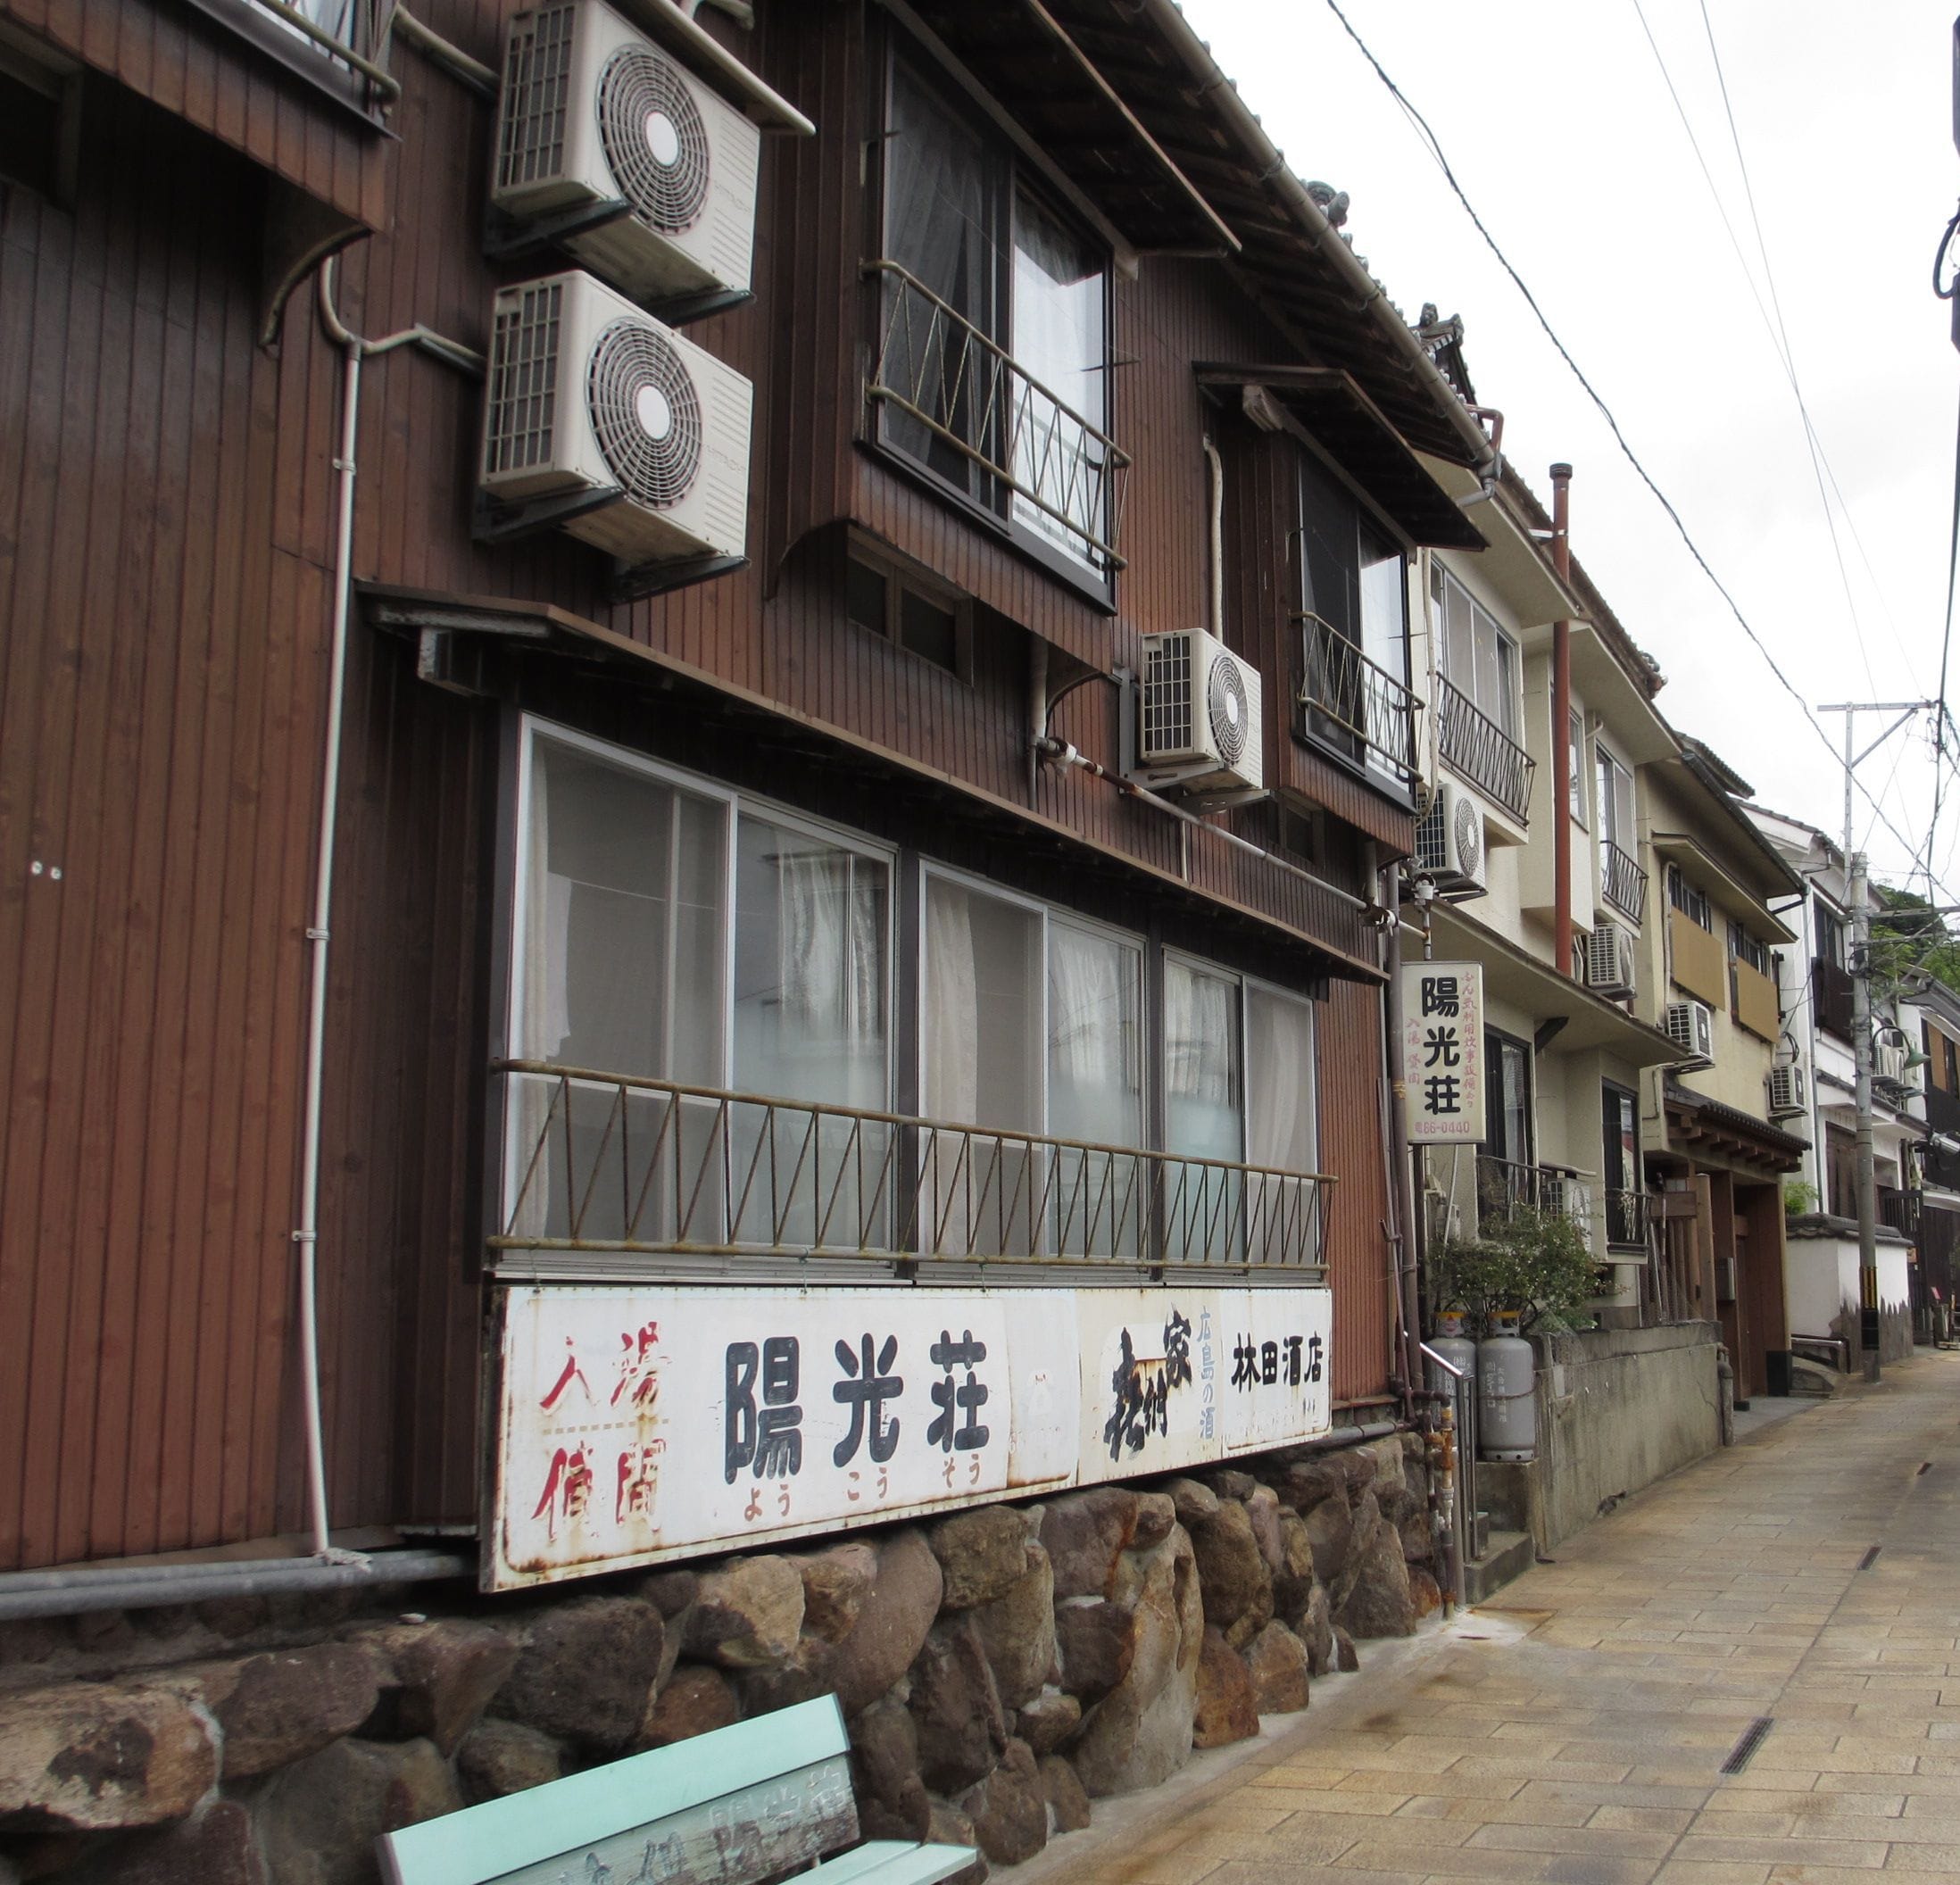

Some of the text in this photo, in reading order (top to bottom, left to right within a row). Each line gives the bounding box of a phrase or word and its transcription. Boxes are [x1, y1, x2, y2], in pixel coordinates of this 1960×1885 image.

[1421, 976, 1461, 1116] 陽光荘
[725, 1329, 990, 1485] 陽光荘
[1196, 1304, 1216, 1440] 広島の酒
[1231, 1330, 1324, 1393] 林田酒店
